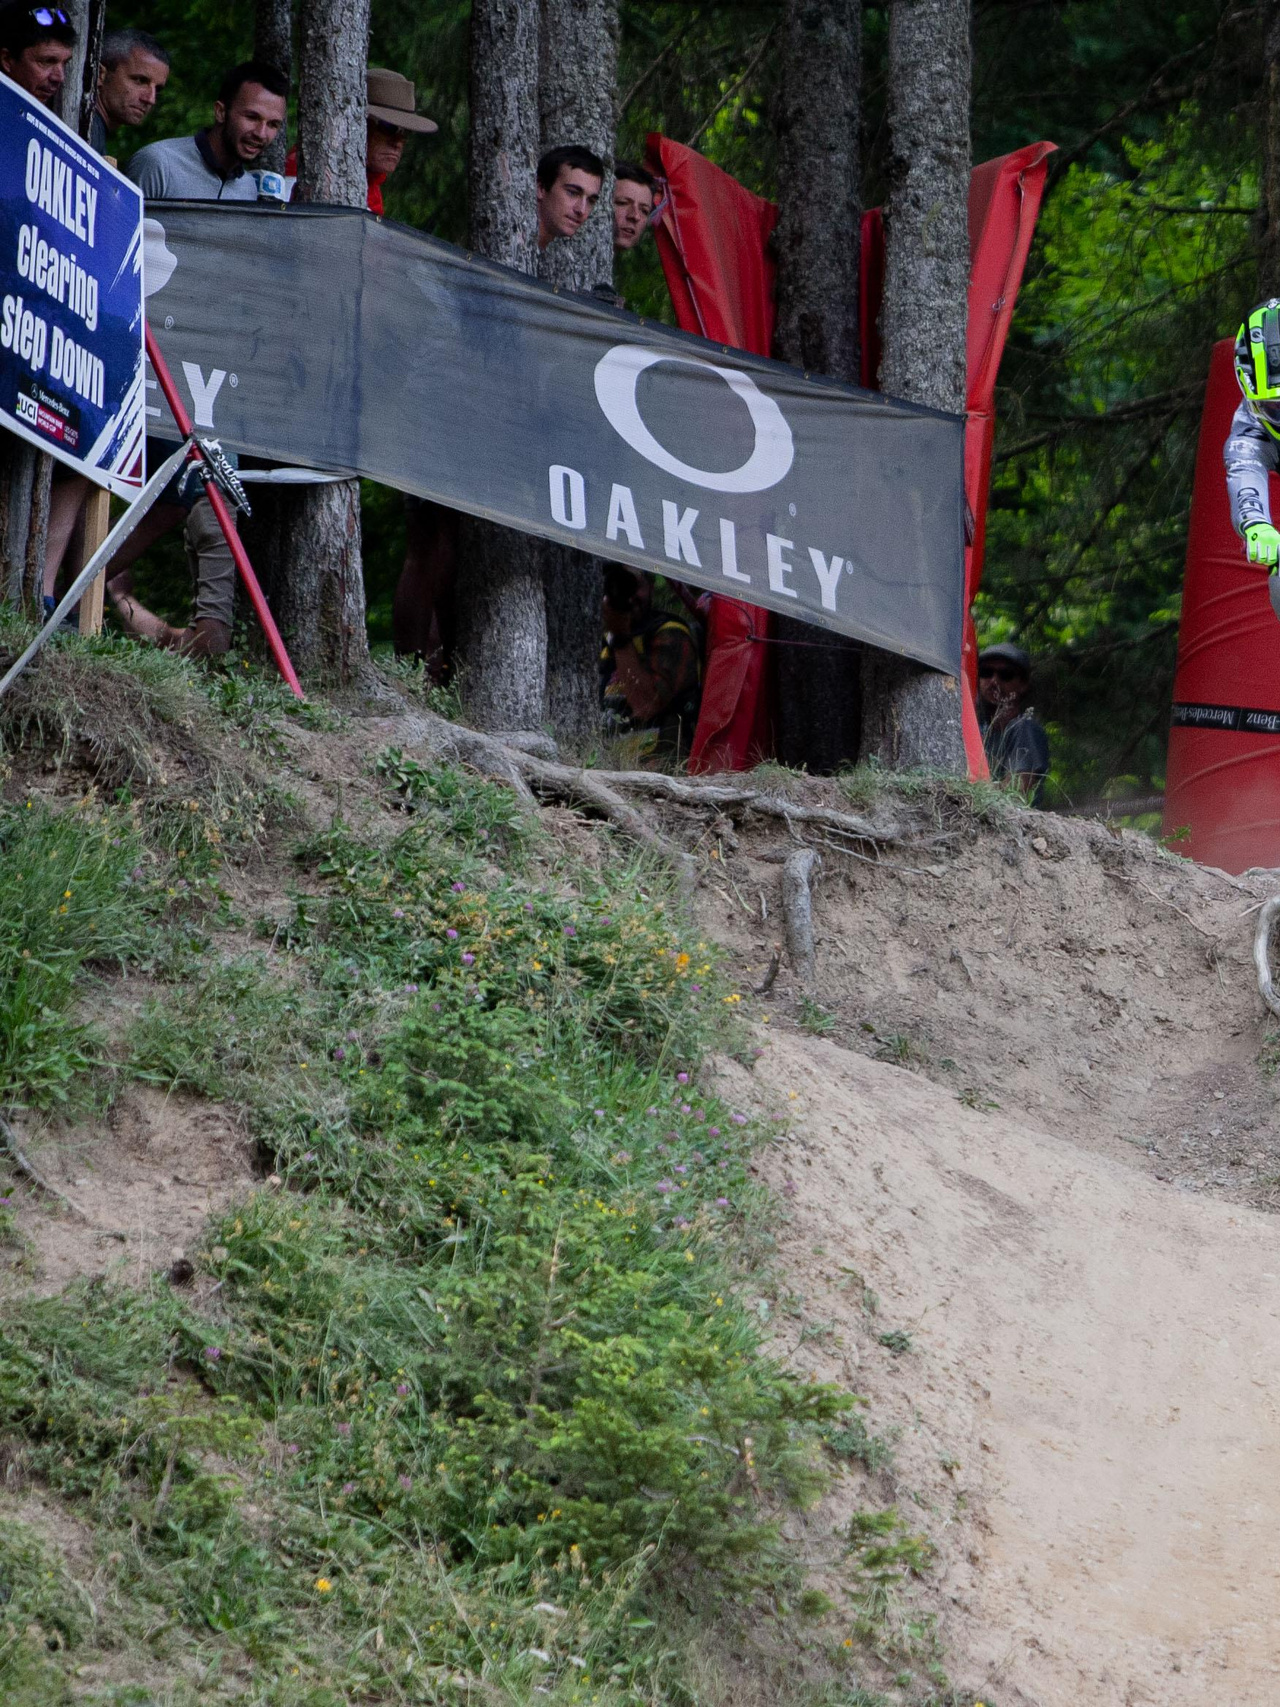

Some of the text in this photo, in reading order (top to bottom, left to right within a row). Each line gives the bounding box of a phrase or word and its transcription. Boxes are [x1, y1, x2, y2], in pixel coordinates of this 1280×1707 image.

[26, 138, 98, 248] OAKLEY
[17, 223, 98, 332] Clearing
[1, 294, 47, 371] Step
[20, 398, 37, 420] UCI
[548, 464, 844, 612] OAKLEY
